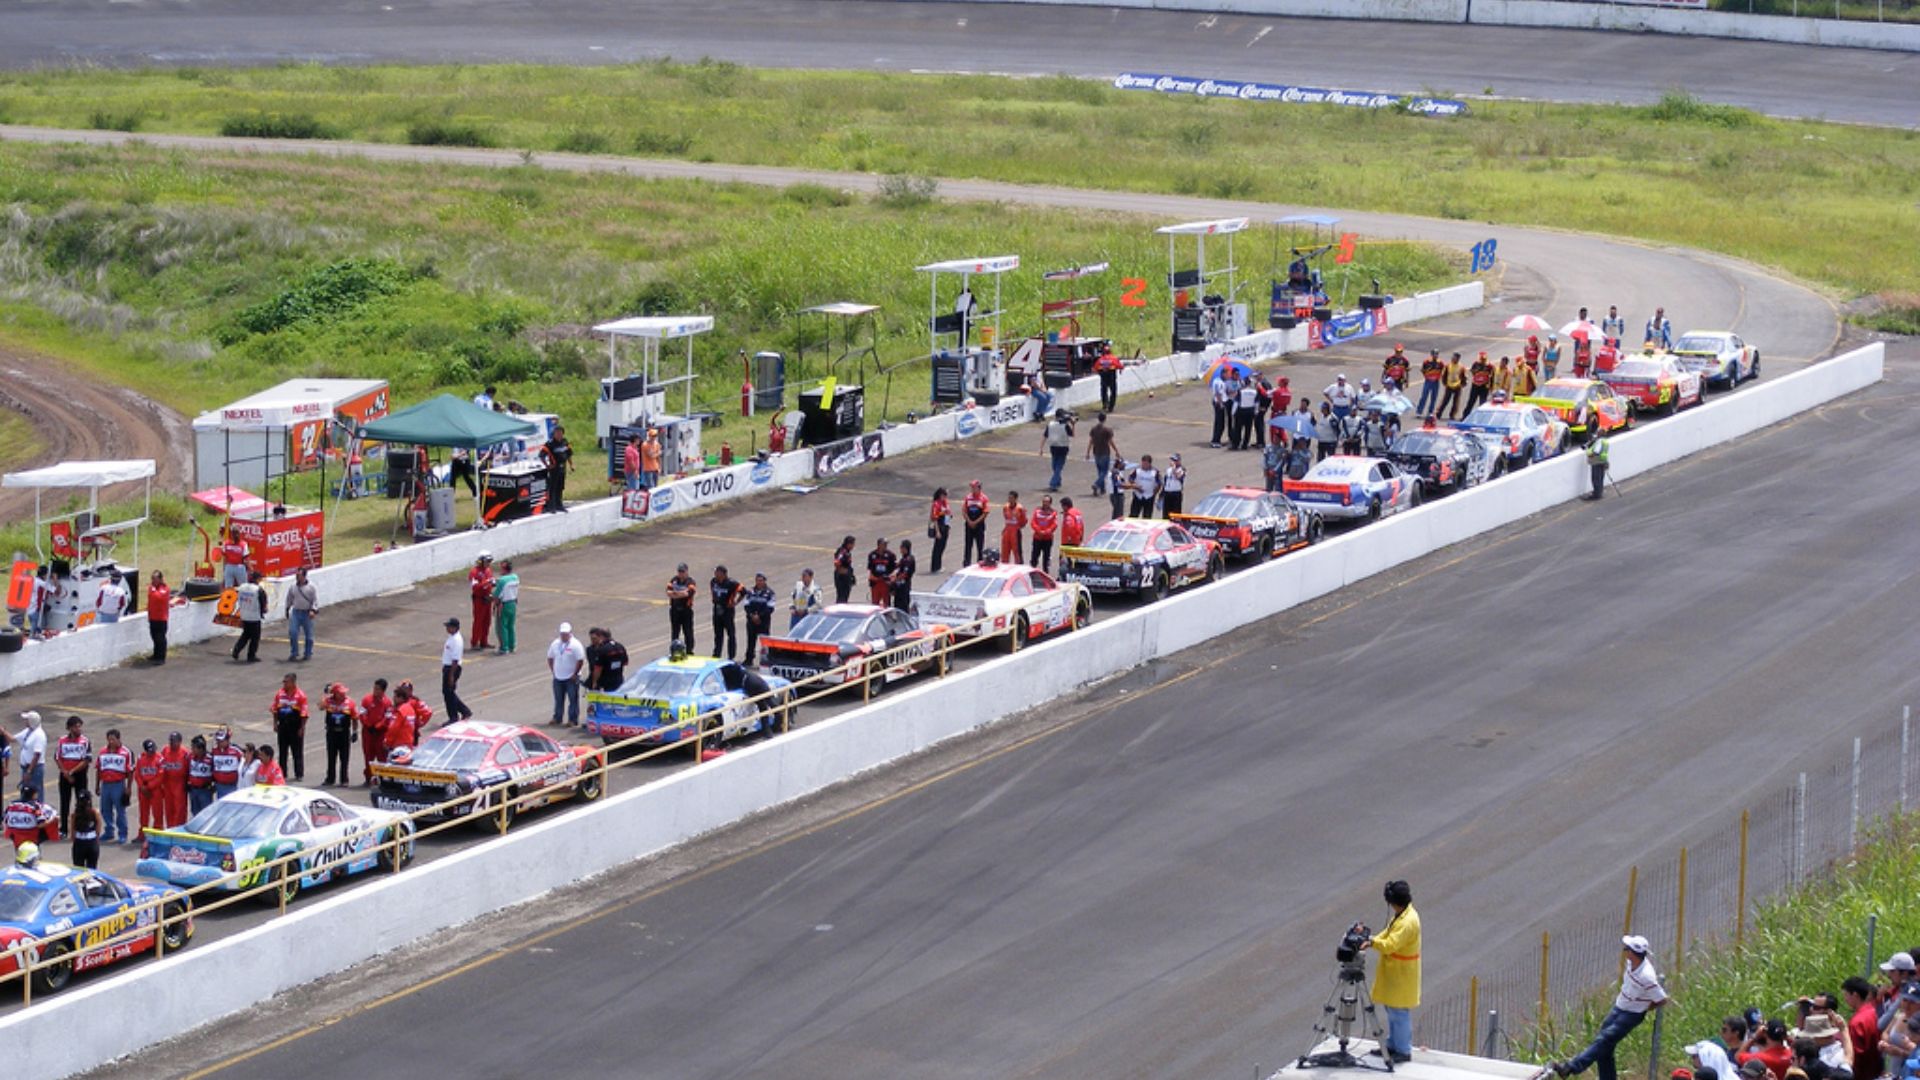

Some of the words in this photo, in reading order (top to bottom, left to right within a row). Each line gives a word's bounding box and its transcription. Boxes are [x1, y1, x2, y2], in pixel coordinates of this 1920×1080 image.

[1335, 233, 1359, 264] 5
[1470, 237, 1497, 273] 18
[1121, 277, 1147, 307] 2
[1006, 337, 1044, 375] 4
[624, 490, 647, 511] 15
[267, 528, 302, 548] NEXTEL
[1141, 565, 1155, 588] 22
[217, 588, 239, 616] 8
[678, 702, 698, 729] 64
